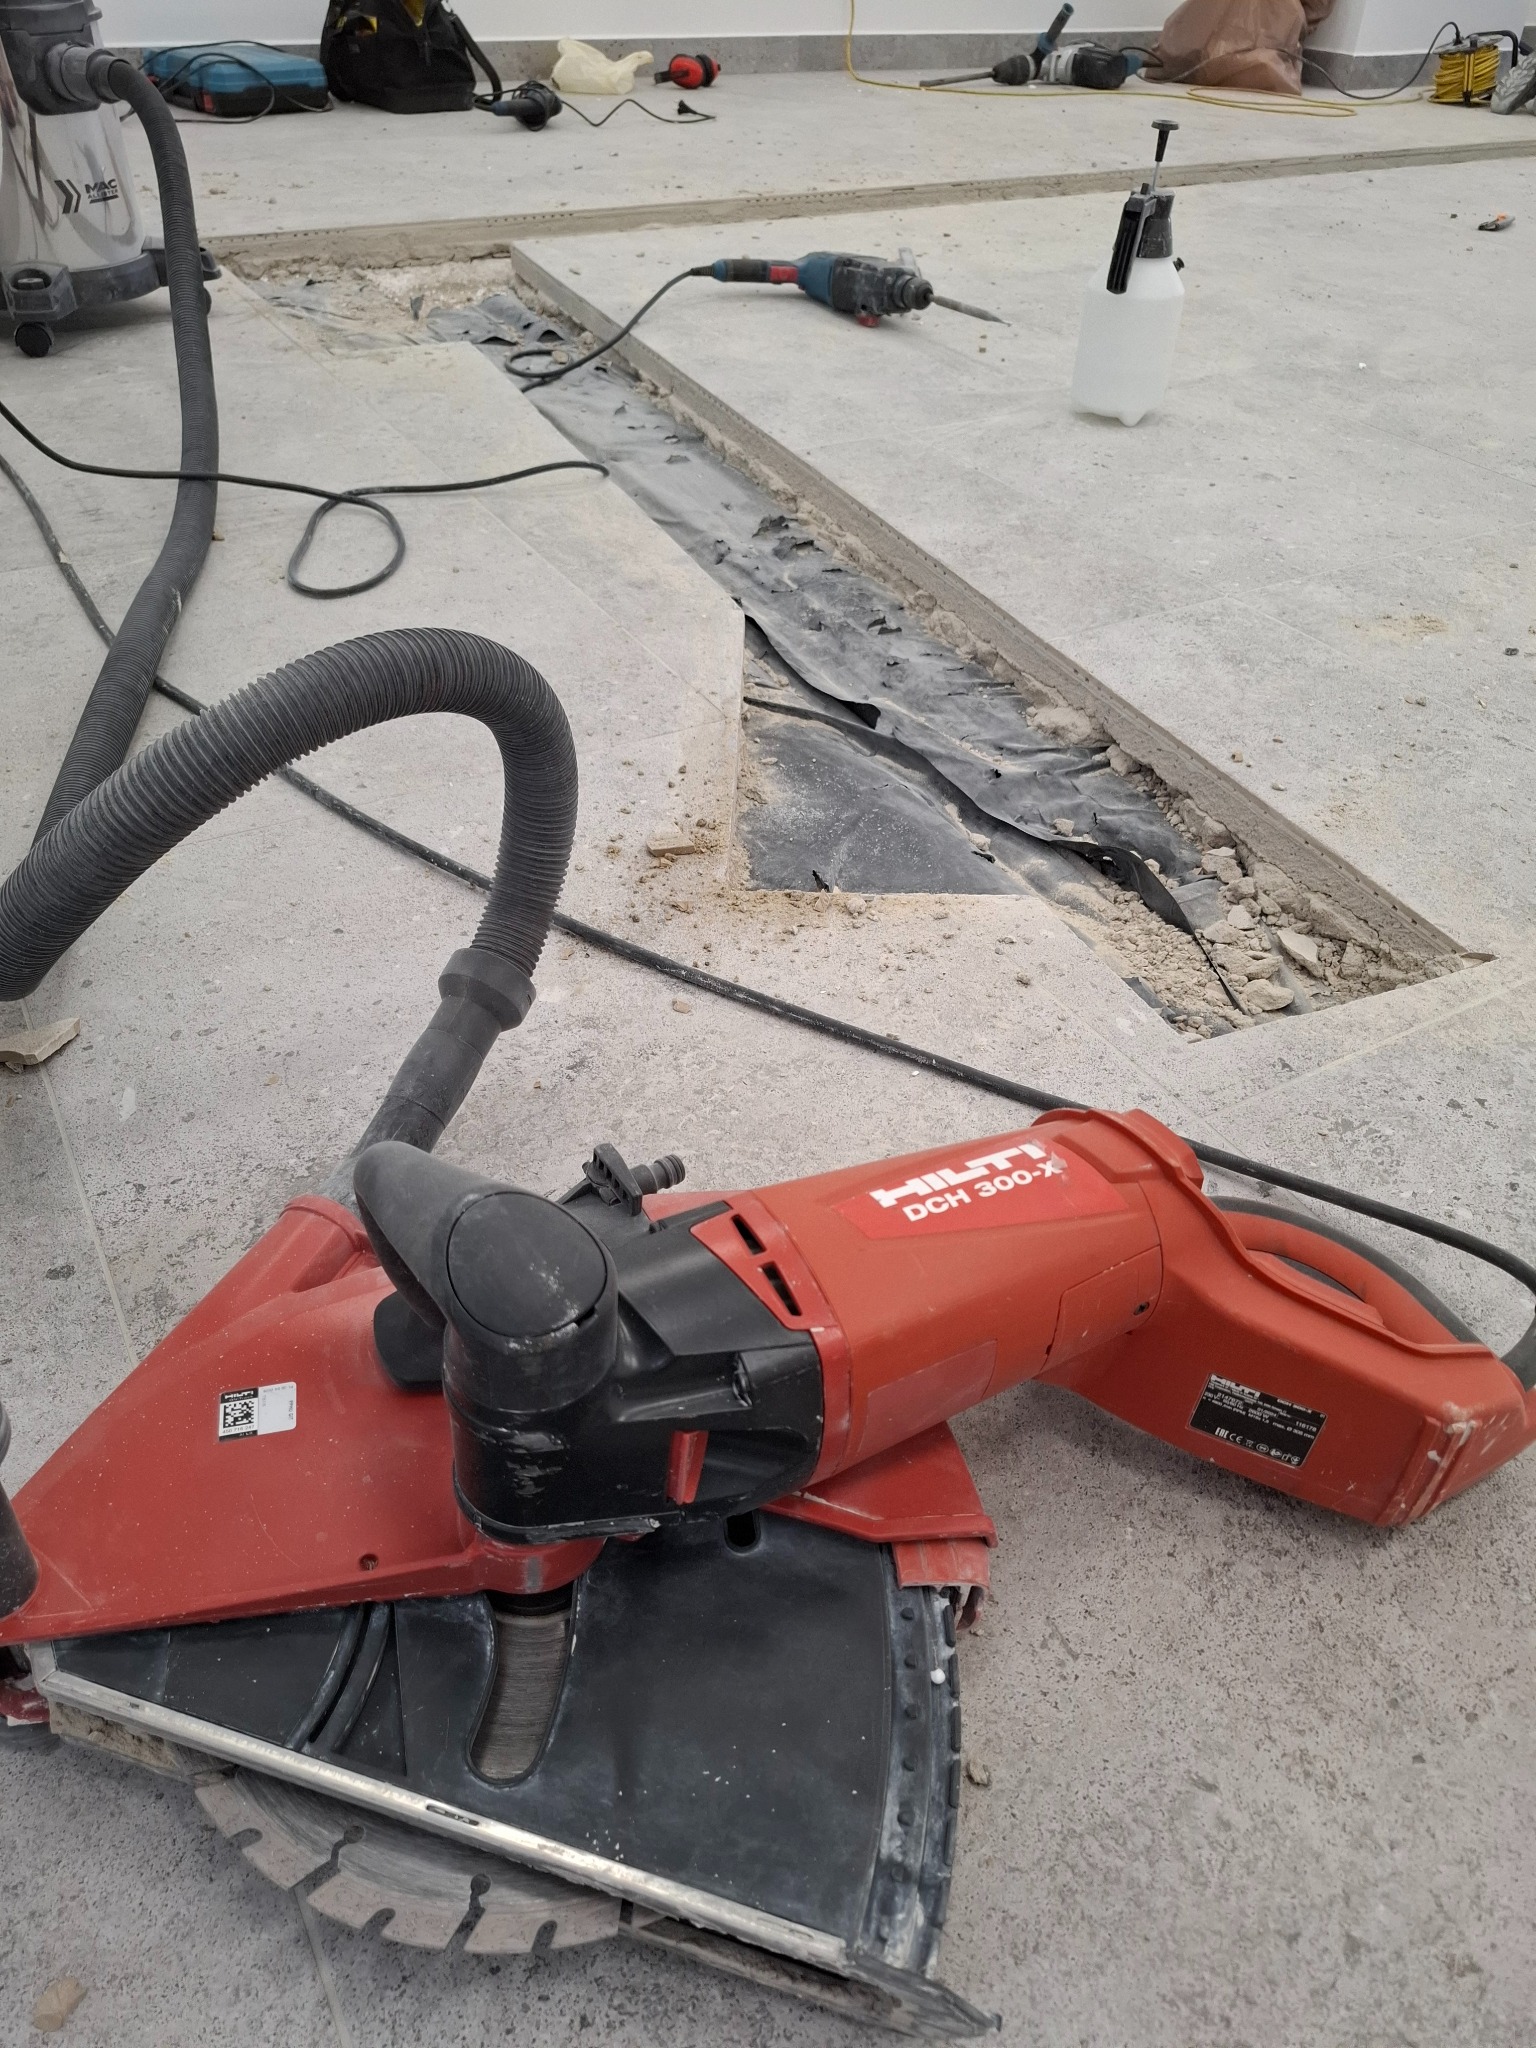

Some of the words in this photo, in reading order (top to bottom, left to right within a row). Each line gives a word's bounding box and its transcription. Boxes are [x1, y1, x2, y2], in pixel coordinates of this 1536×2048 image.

[85, 179, 117, 194] MAC
[869, 1143, 1047, 1208] HILTI
[902, 1188, 972, 1222] DCH
[974, 1159, 1064, 1198] 300-X
[225, 1390, 254, 1399] HILTI
[1210, 1374, 1260, 1400] HILTI
